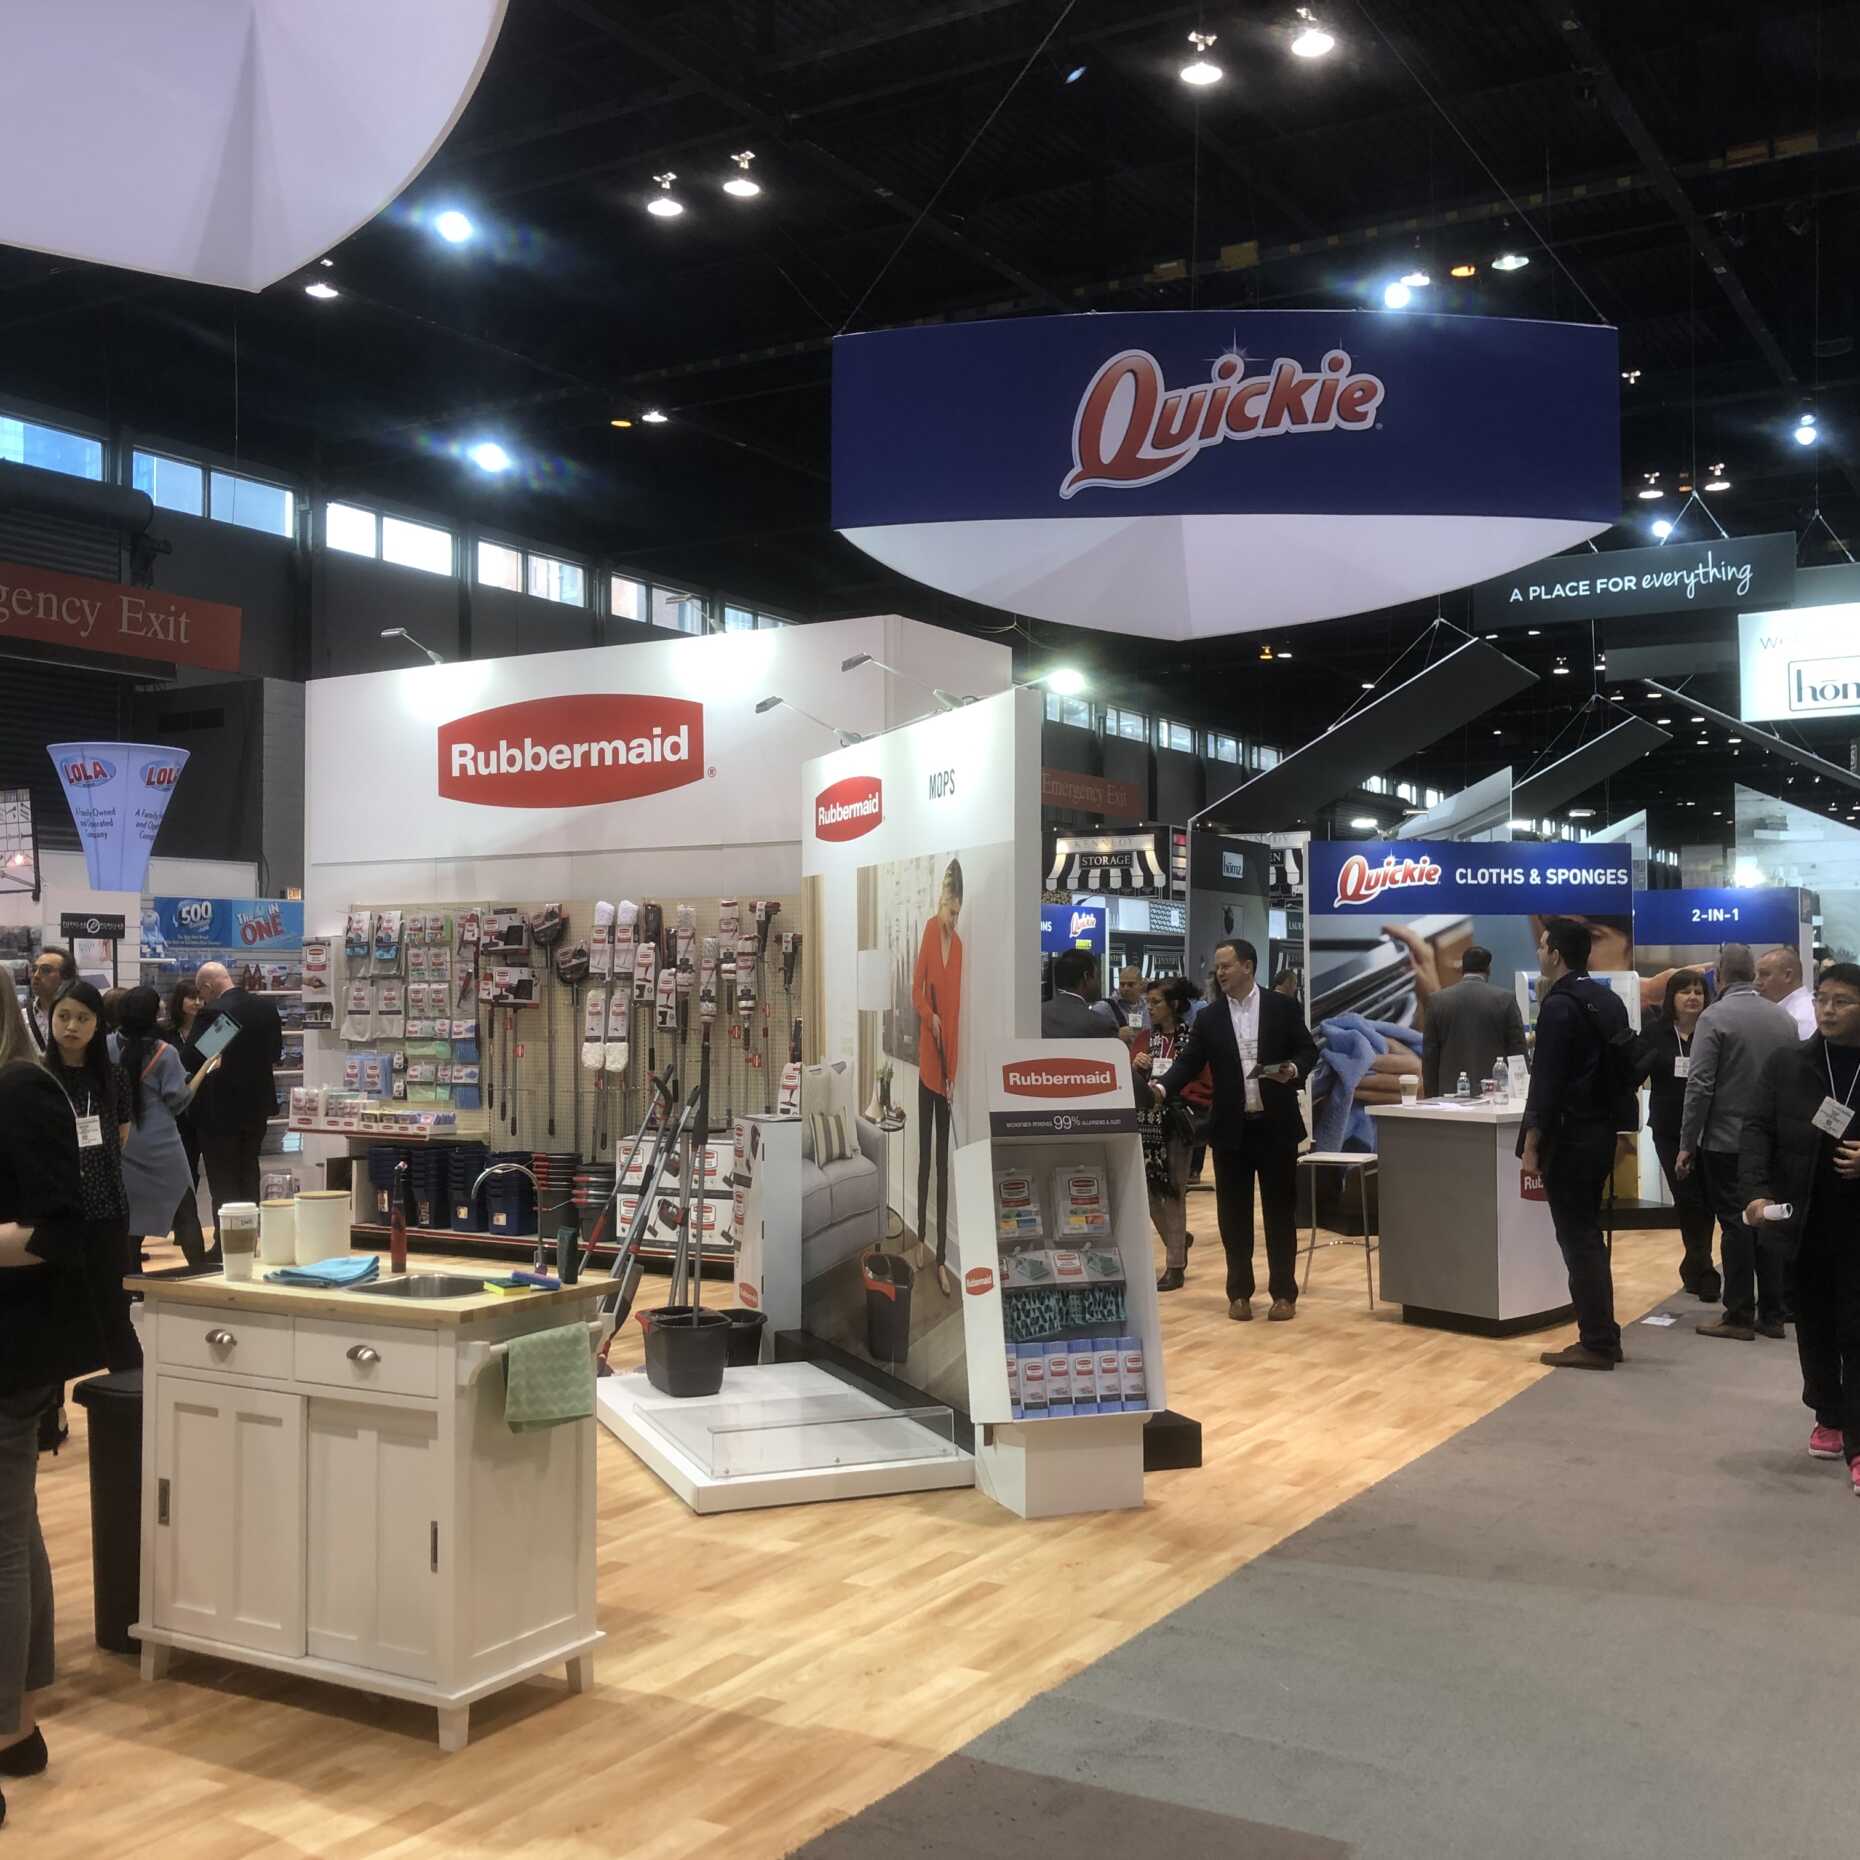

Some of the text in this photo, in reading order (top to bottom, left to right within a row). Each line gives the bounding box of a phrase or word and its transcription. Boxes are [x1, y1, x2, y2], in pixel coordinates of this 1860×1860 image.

[1059, 349, 1385, 500] Quickie
[1509, 551, 1752, 602] A PLACE FOR everything
[118, 595, 191, 643] Exit
[451, 725, 689, 776] Rubbermaid
[64, 761, 108, 784] LOLA
[145, 767, 178, 786] LOL
[929, 769, 956, 800] MOPS
[818, 792, 879, 826] Rubbermaid
[1081, 855, 1131, 866] STORAGE
[1333, 855, 1442, 908] Quickie
[1455, 868, 1629, 886] CLOTHS & SPONGES
[181, 901, 212, 925] 500
[1692, 908, 1739, 923] 2-IN-1
[241, 914, 284, 945] ONE
[1008, 1071, 1111, 1086] Rubbermaid
